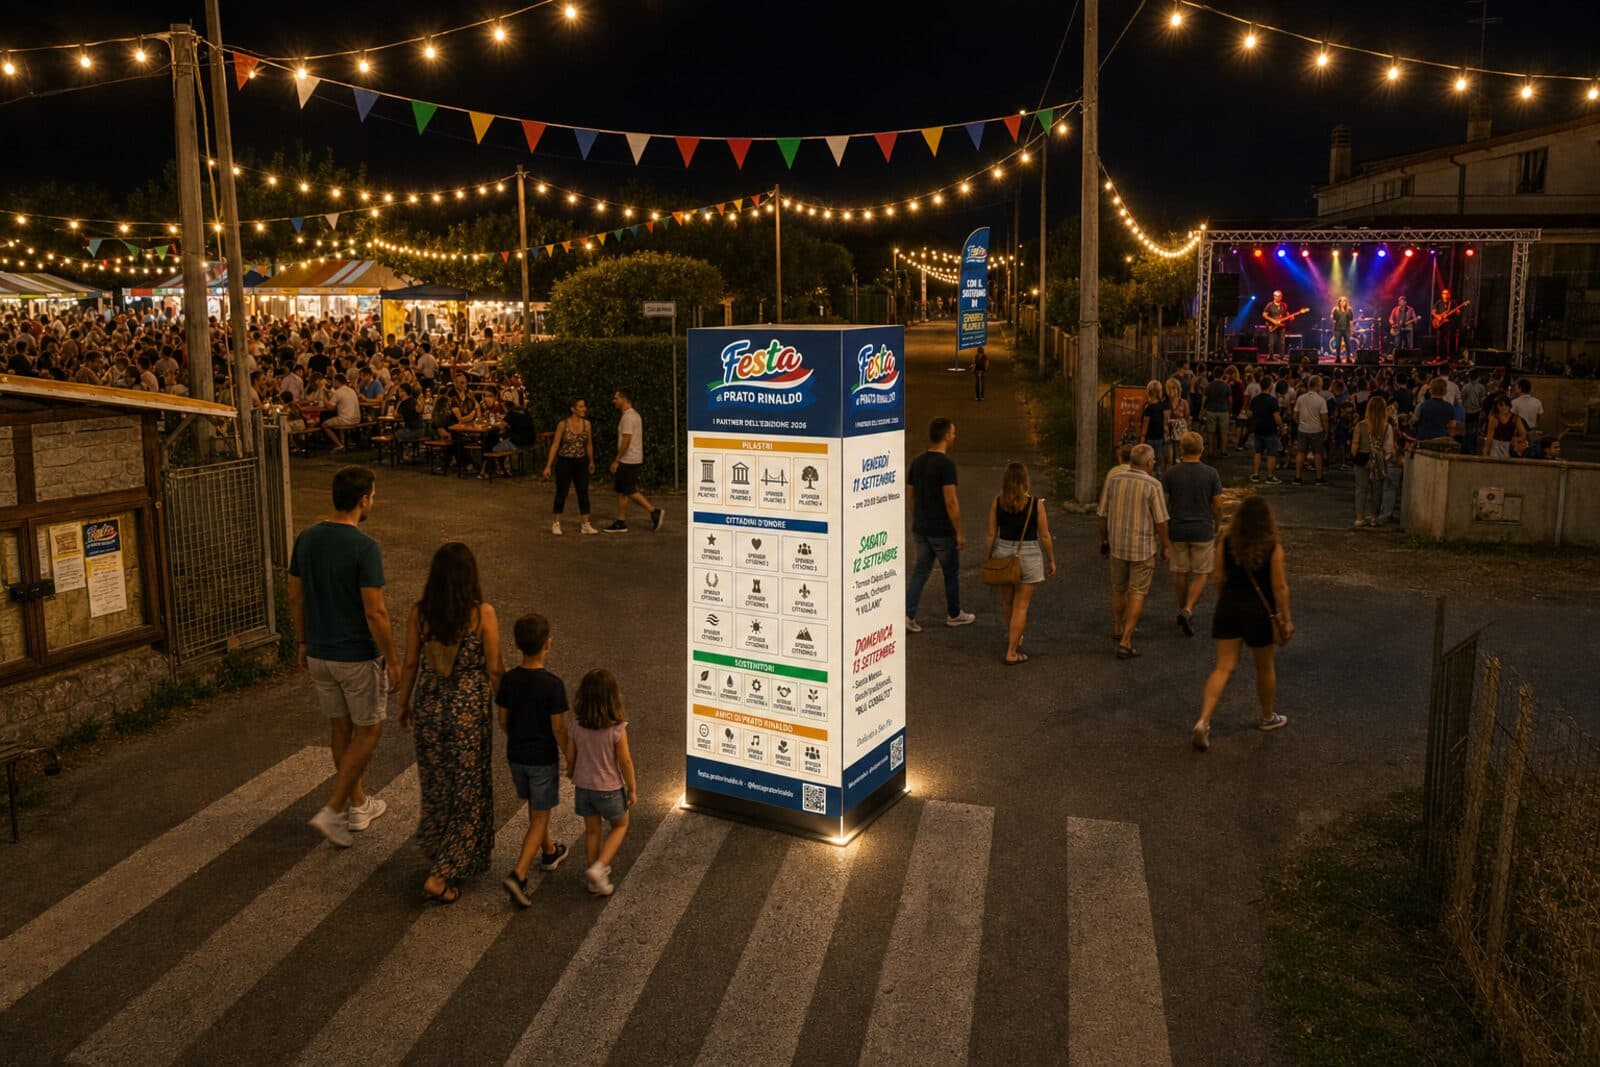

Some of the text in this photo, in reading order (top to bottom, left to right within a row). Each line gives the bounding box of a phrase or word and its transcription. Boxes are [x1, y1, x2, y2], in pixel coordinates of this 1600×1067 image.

[721, 339, 803, 386] Festa
[858, 343, 896, 386] Festa
[724, 391, 755, 402] PRATO
[757, 392, 803, 405] RINALDO
[744, 420, 789, 428] DELL'EDIZIONE
[742, 441, 773, 450] PILASTRI
[862, 450, 890, 472] VENERDÌ
[853, 470, 896, 493] 11 SETTEMBRE
[726, 516, 786, 529] CITTADINI D'ONORE
[858, 530, 888, 554] SABATO
[853, 546, 898, 574] 12 SETTEMBRE
[854, 623, 893, 656] DOMENICA
[735, 659, 775, 672] SOSTENITORI
[853, 640, 896, 675] 13 SETTEMBRE
[714, 710, 734, 721] AMICI
[742, 714, 763, 727] PRATO
[764, 719, 794, 733] RINALDO
